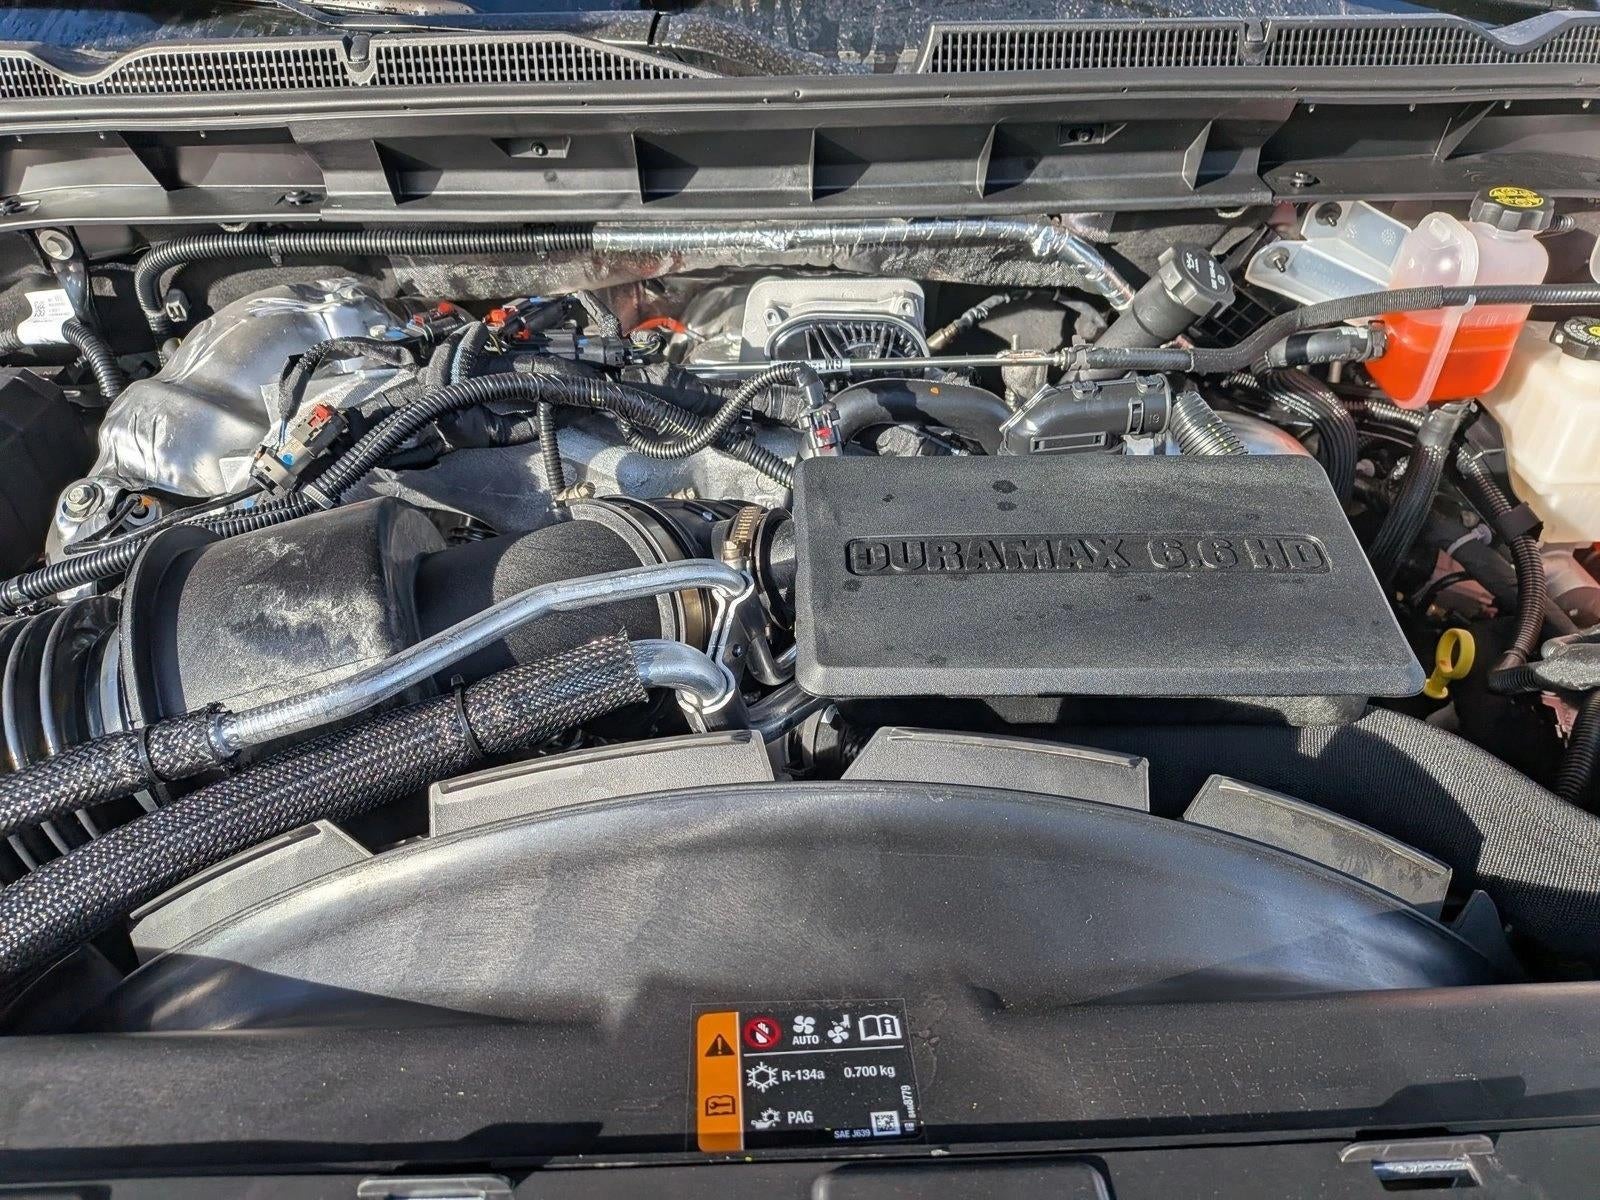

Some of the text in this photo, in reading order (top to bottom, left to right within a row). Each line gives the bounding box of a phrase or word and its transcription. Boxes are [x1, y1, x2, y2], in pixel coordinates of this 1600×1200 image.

[846, 535, 1332, 575] DURAMAX 6.6 HD
[792, 1035, 820, 1046] AUTO
[782, 1064, 896, 1082] R-134a 0.700 kg
[787, 1111, 814, 1124] PAG
[834, 1131, 850, 1139] SAE
